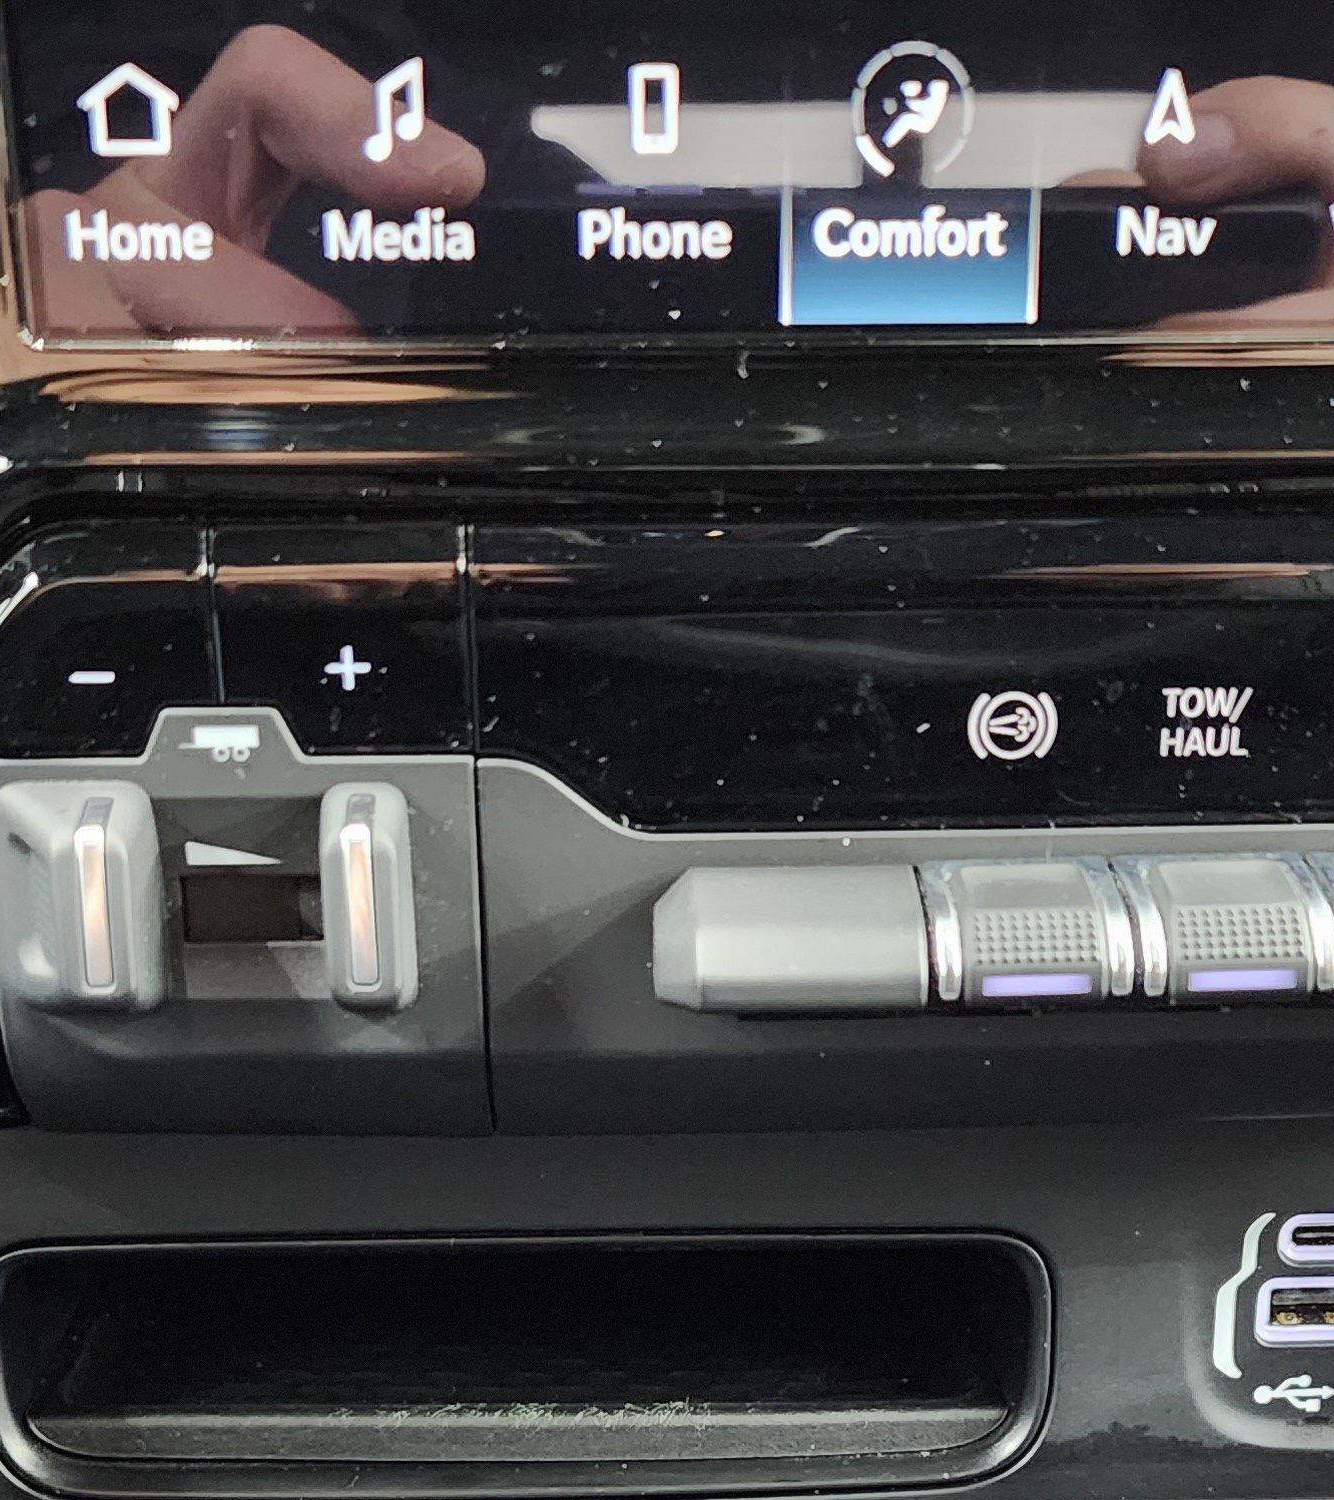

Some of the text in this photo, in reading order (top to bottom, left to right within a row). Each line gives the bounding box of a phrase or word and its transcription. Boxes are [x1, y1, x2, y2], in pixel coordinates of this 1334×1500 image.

[65, 209, 214, 262] Home
[321, 207, 476, 262] Media
[577, 207, 733, 261] Phone
[813, 204, 1009, 259] Comfort
[1115, 205, 1218, 257] Nav
[1161, 686, 1254, 724] TOW/
[1159, 724, 1249, 758] HAUL
